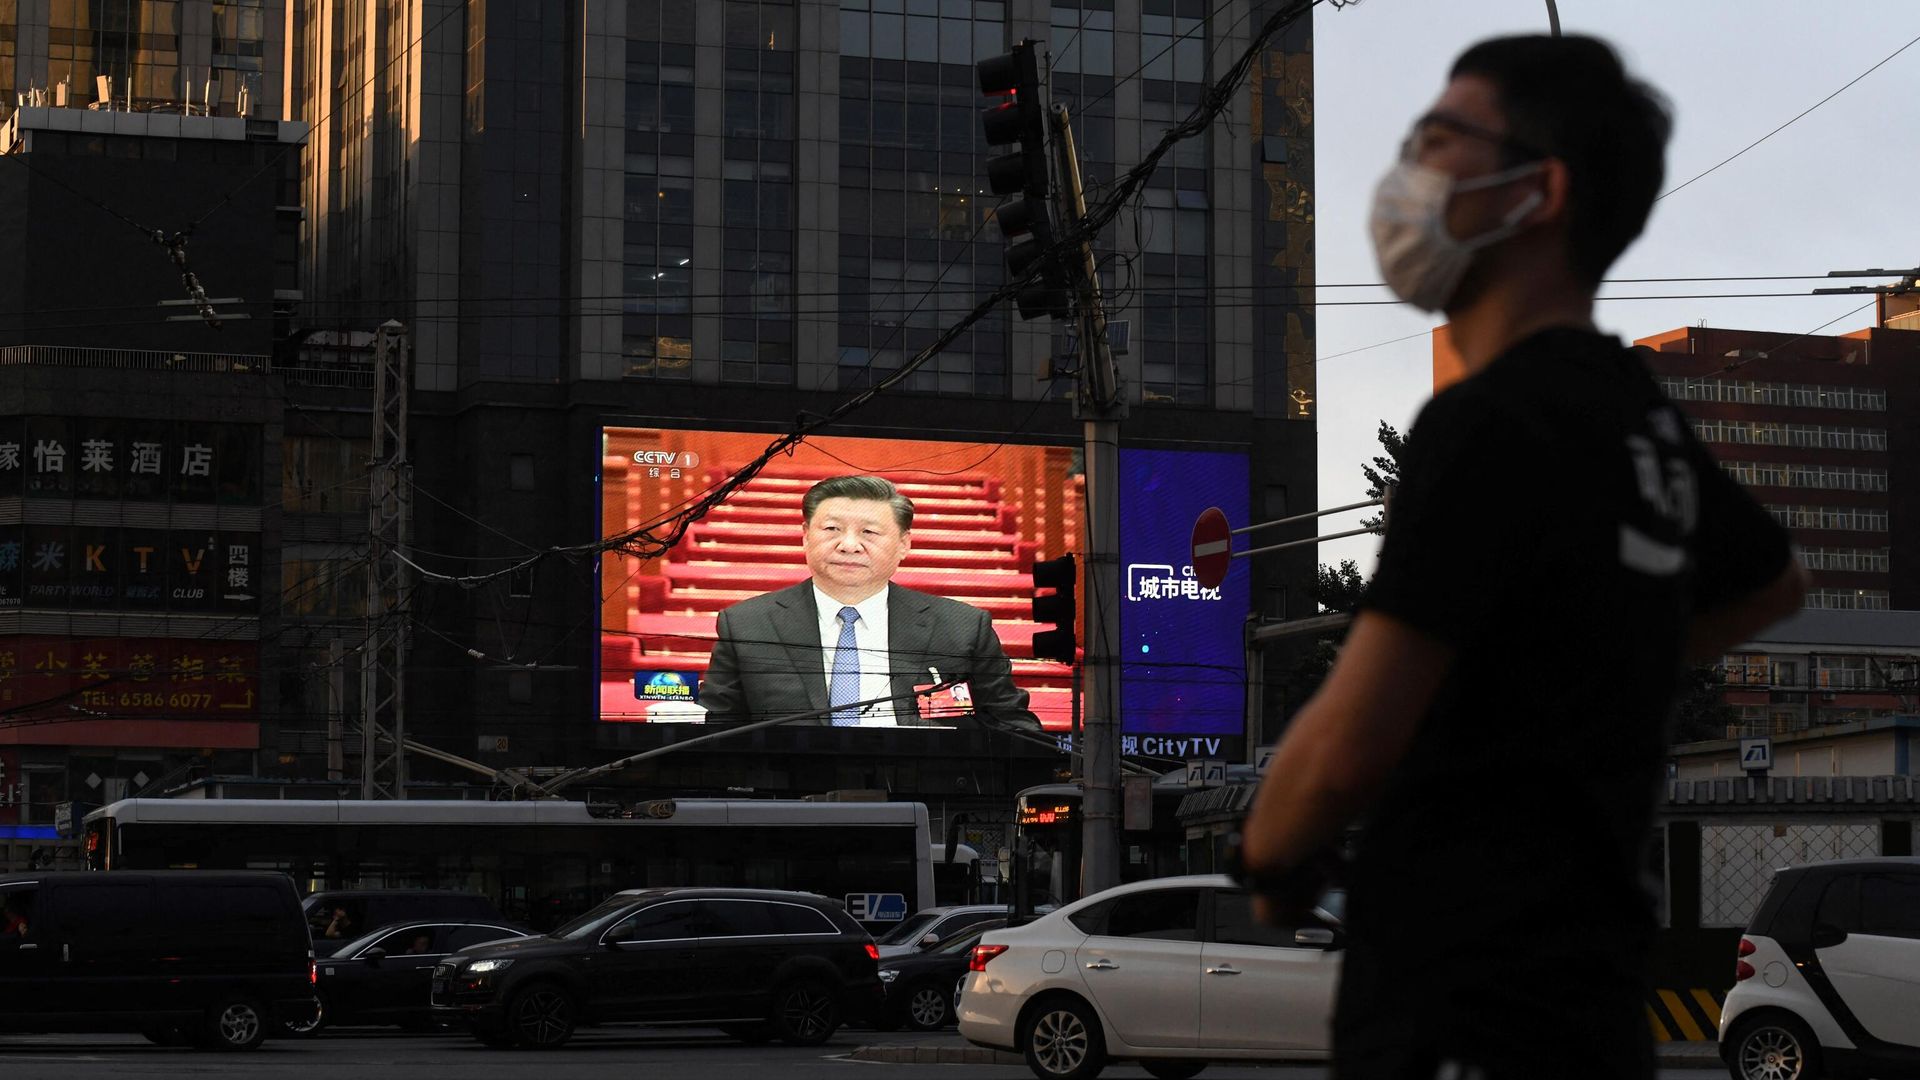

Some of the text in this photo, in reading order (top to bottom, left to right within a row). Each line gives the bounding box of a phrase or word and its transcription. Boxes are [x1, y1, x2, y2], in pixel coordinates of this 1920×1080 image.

[0, 439, 213, 476] 家怡莱酒店
[633, 450, 676, 464] CCTV
[648, 467, 680, 479] 综合
[228, 544, 249, 588] 四楼
[30, 584, 66, 596] PARTY
[71, 585, 114, 598] WORLD
[173, 588, 204, 599] CLUB
[644, 684, 690, 695] 新闻联播
[82, 690, 213, 710] TEL: 6586 6077
[1142, 737, 1221, 757] CityTV
